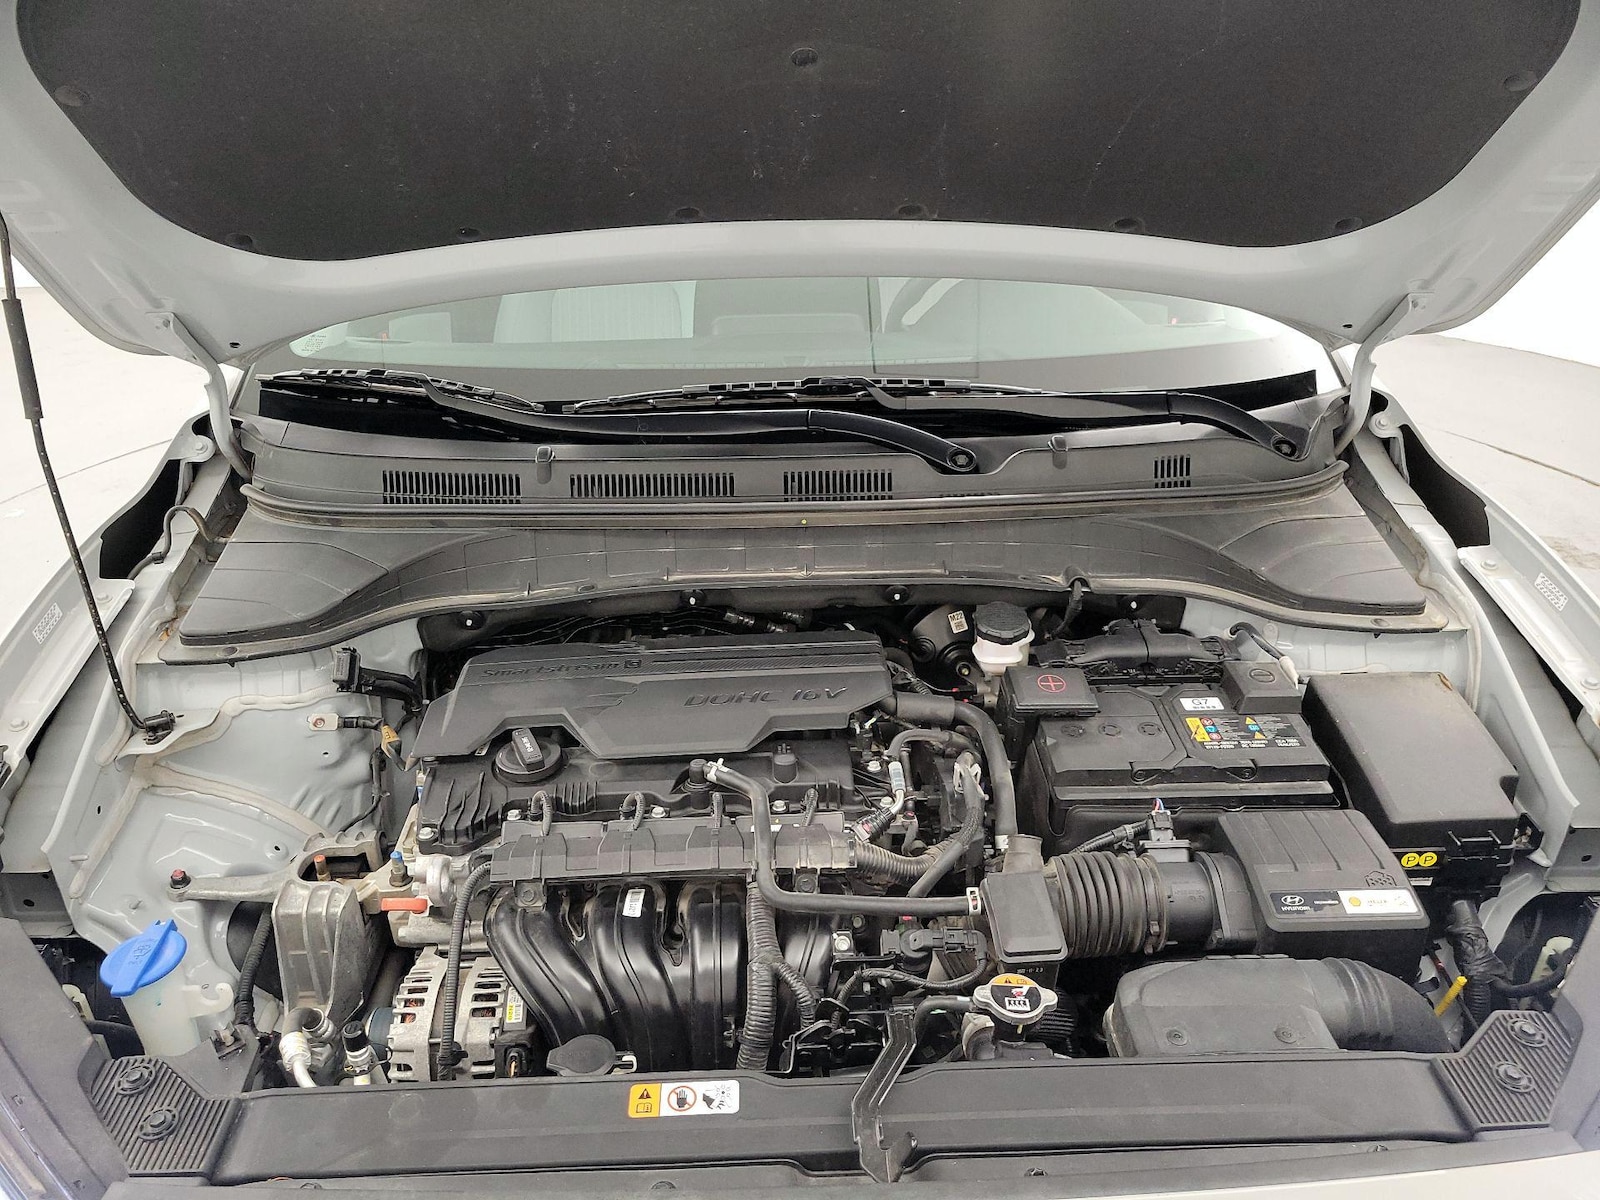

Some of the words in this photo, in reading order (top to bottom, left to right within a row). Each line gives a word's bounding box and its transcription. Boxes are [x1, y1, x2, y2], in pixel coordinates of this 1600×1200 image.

[481, 662, 619, 678] Smartstream
[683, 689, 783, 708] DOHC
[1191, 698, 1208, 706] G7
